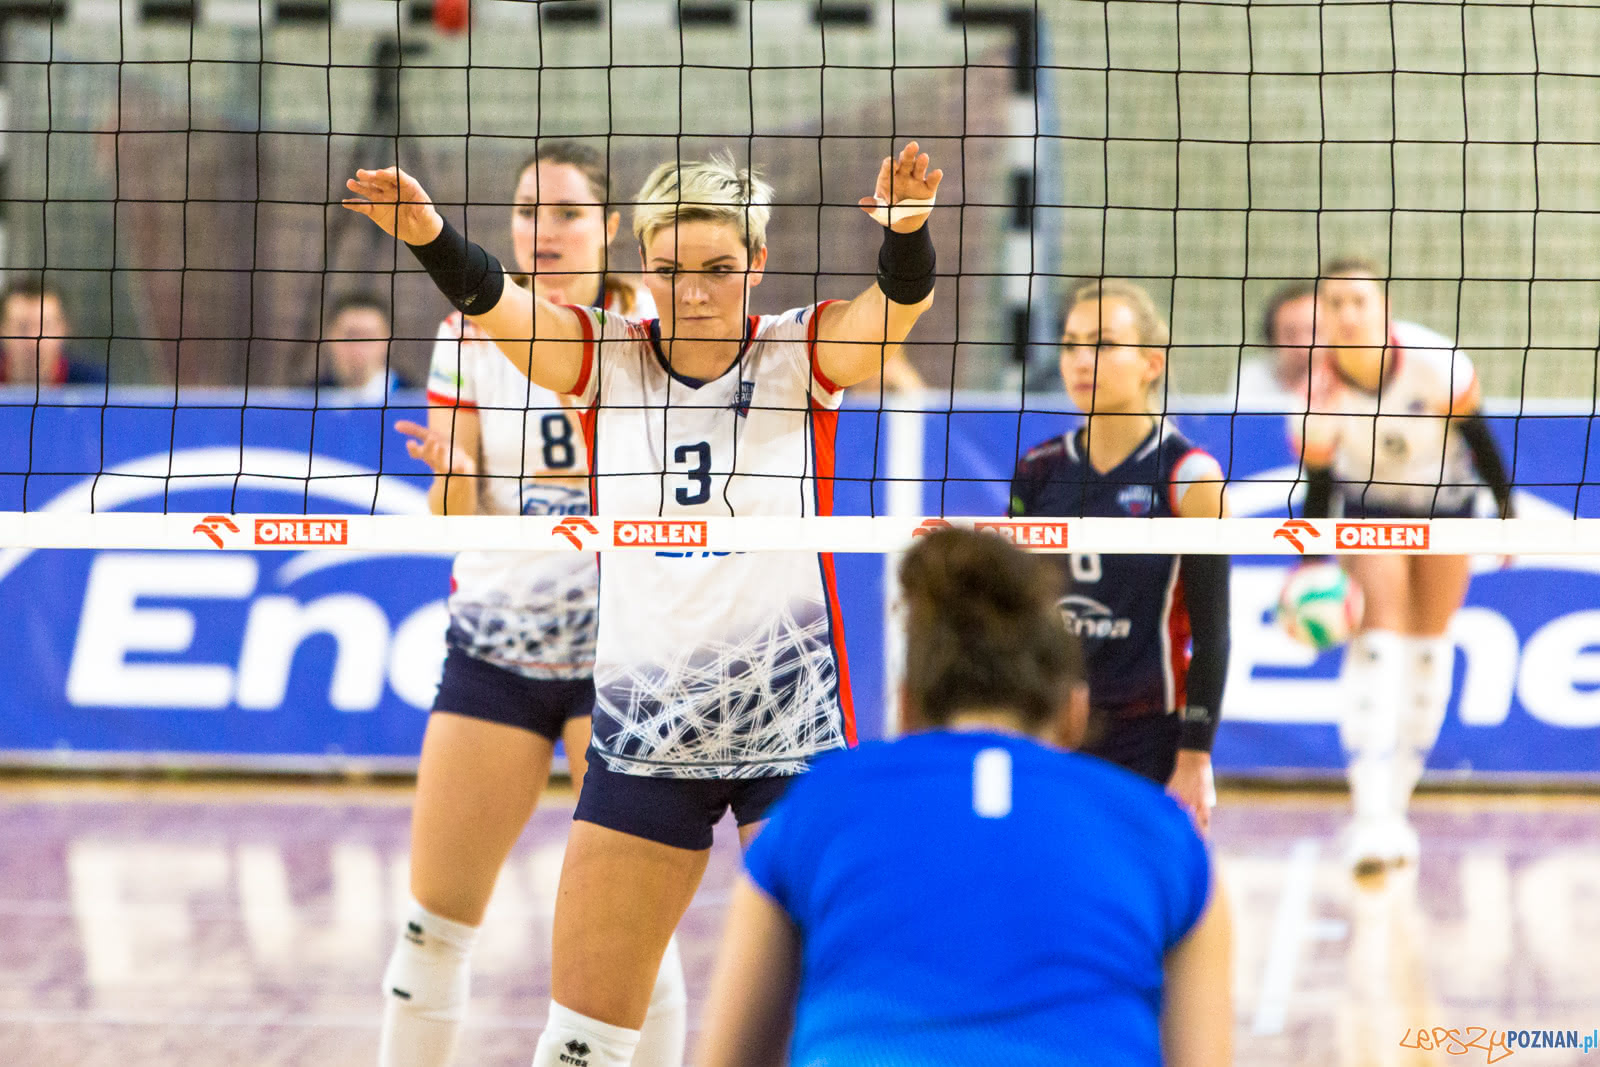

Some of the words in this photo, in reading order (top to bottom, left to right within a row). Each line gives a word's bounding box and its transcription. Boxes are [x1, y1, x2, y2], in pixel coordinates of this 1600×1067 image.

[541, 413, 575, 469] 8
[674, 441, 712, 506] 3
[259, 522, 342, 541] ORLEN
[618, 523, 701, 543] ORLEN
[1340, 527, 1424, 546] ORLEN
